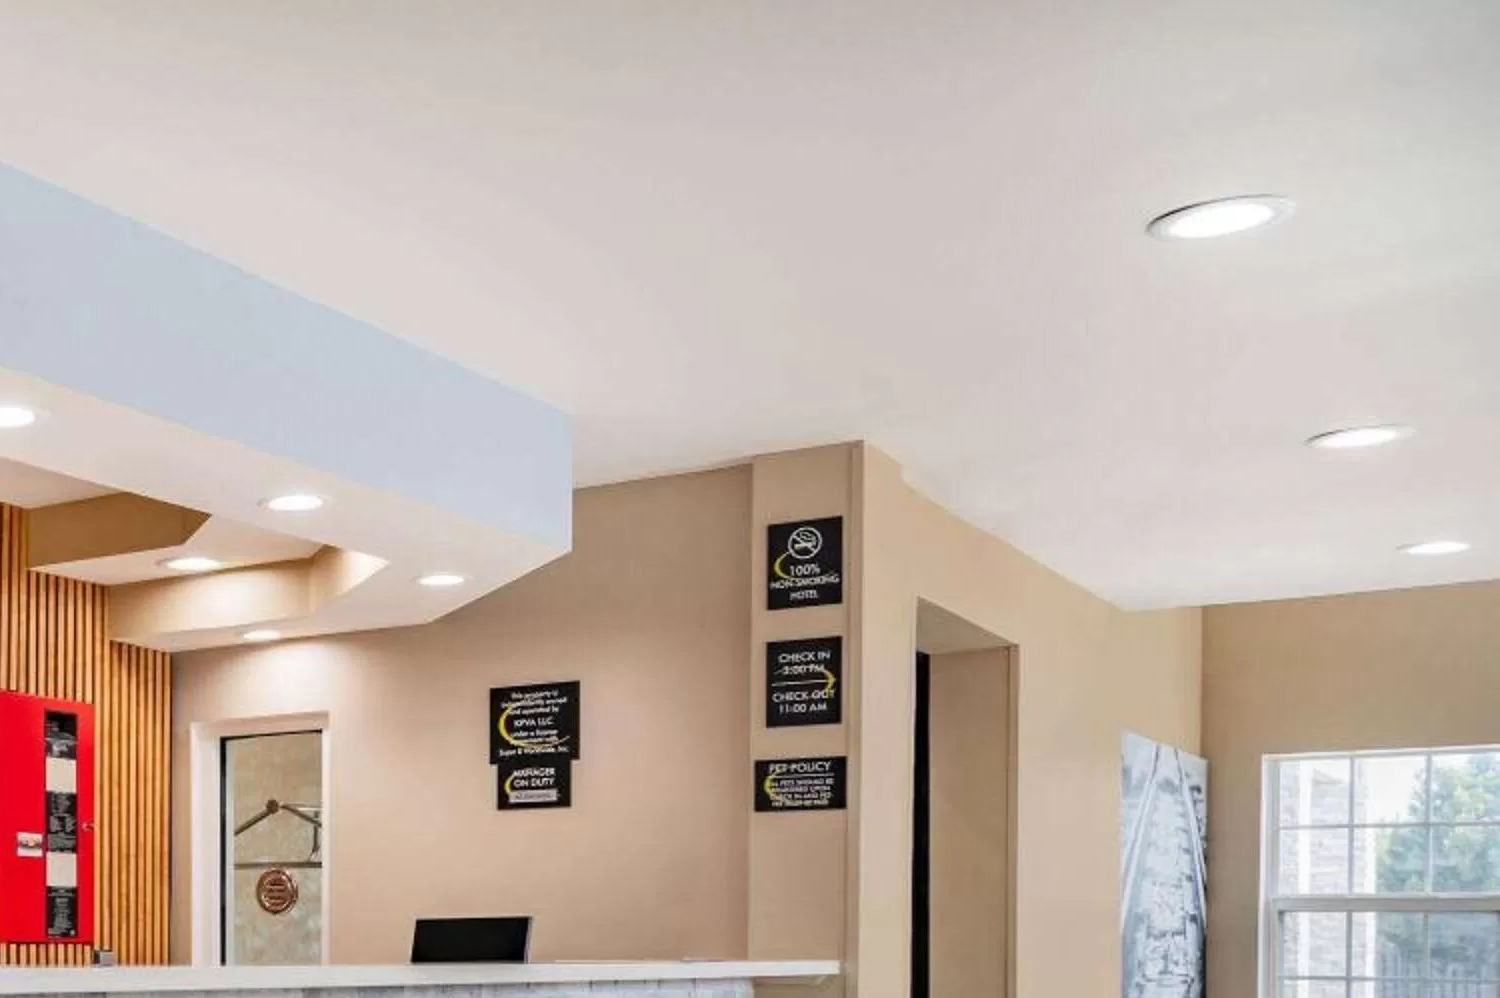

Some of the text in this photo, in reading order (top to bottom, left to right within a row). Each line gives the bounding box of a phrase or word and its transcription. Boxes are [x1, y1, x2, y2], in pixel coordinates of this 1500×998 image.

[790, 564, 820, 576] 100%
[790, 590, 818, 600] HOTEL
[778, 650, 831, 663] CHECK IN
[772, 691, 808, 703] CHECK
[780, 702, 827, 713] 11:00 AM
[538, 716, 554, 725] LLC
[769, 761, 831, 773] PET POLICY
[513, 768, 555, 787] MANAGER ON DUTY
